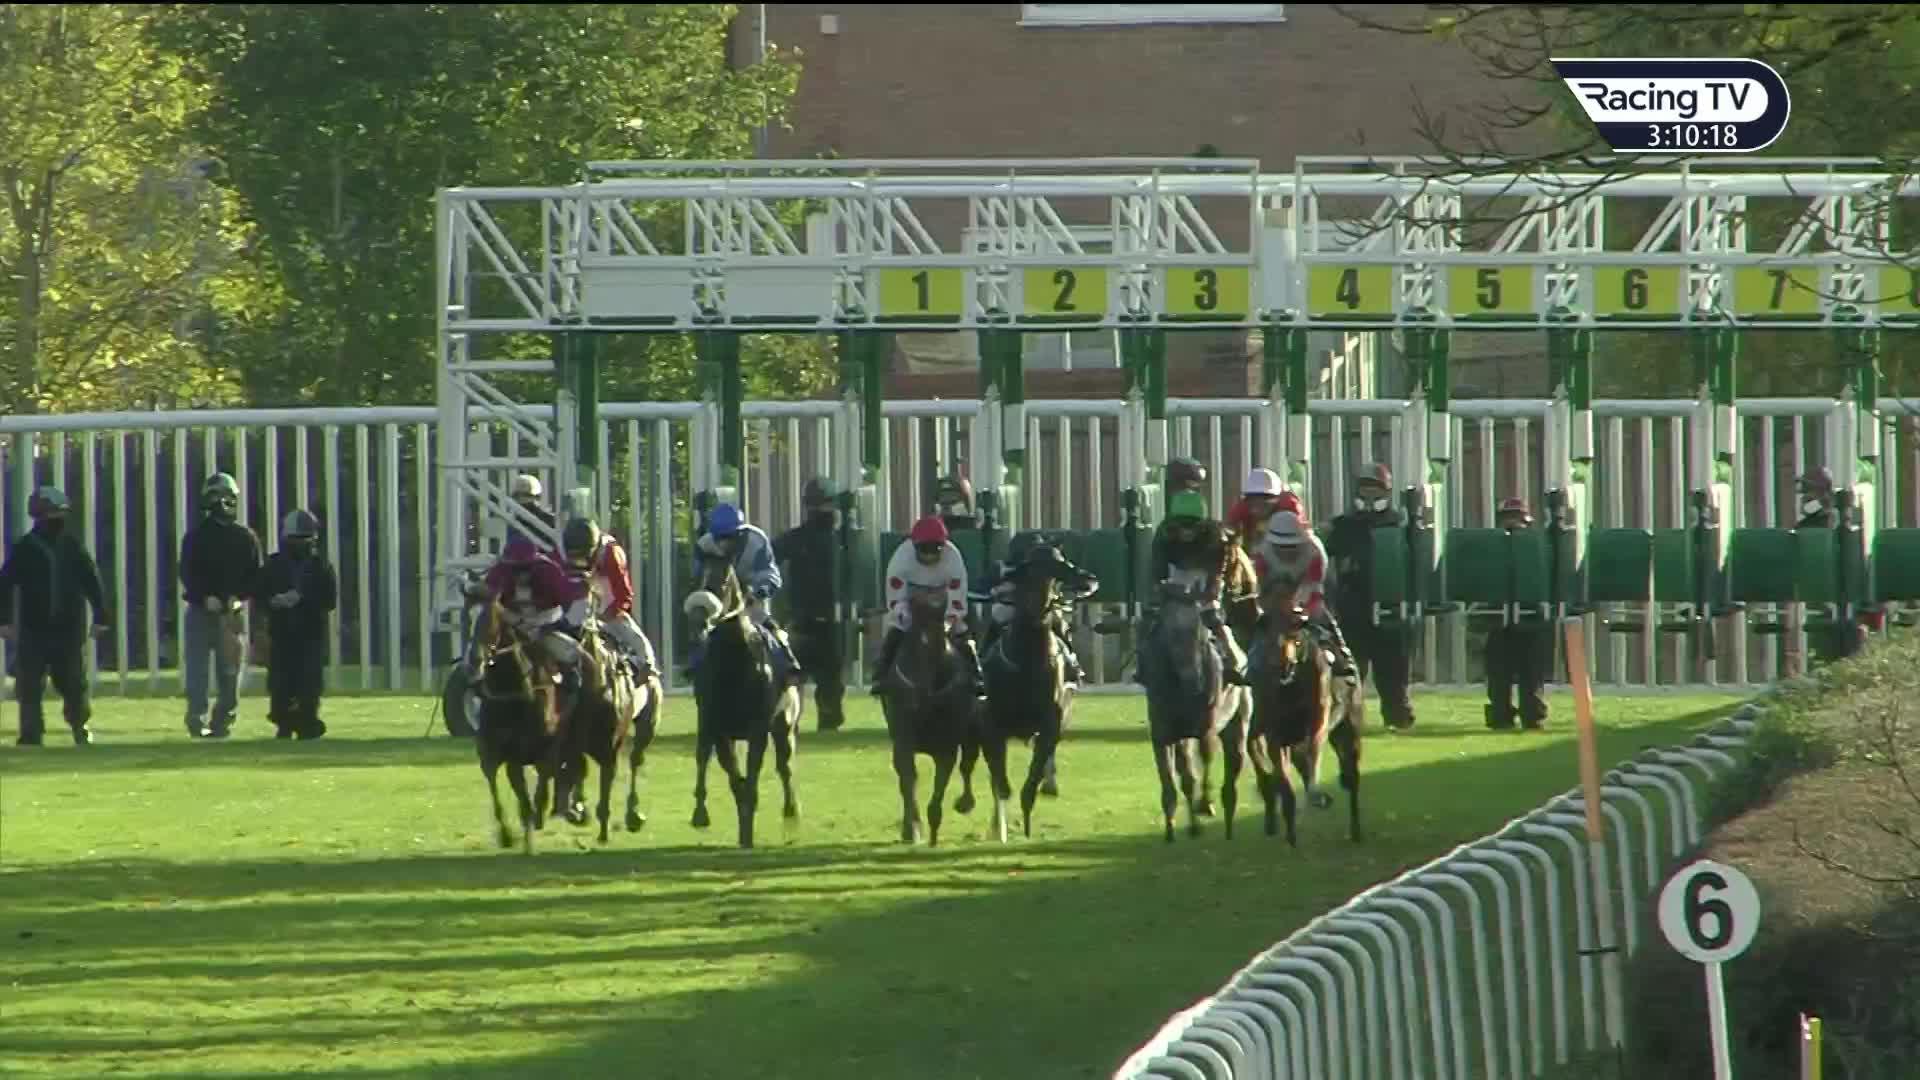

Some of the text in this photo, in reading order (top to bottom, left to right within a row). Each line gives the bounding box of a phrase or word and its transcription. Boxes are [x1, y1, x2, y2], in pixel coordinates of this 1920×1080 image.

[911, 271, 930, 311] 1
[1053, 269, 1077, 311] 2
[1193, 269, 1218, 311] 3
[1335, 269, 1361, 310] 4
[1476, 269, 1500, 309] 5
[1623, 269, 1648, 308] 6
[1768, 269, 1787, 309] 7
[1684, 872, 1734, 950] 6
